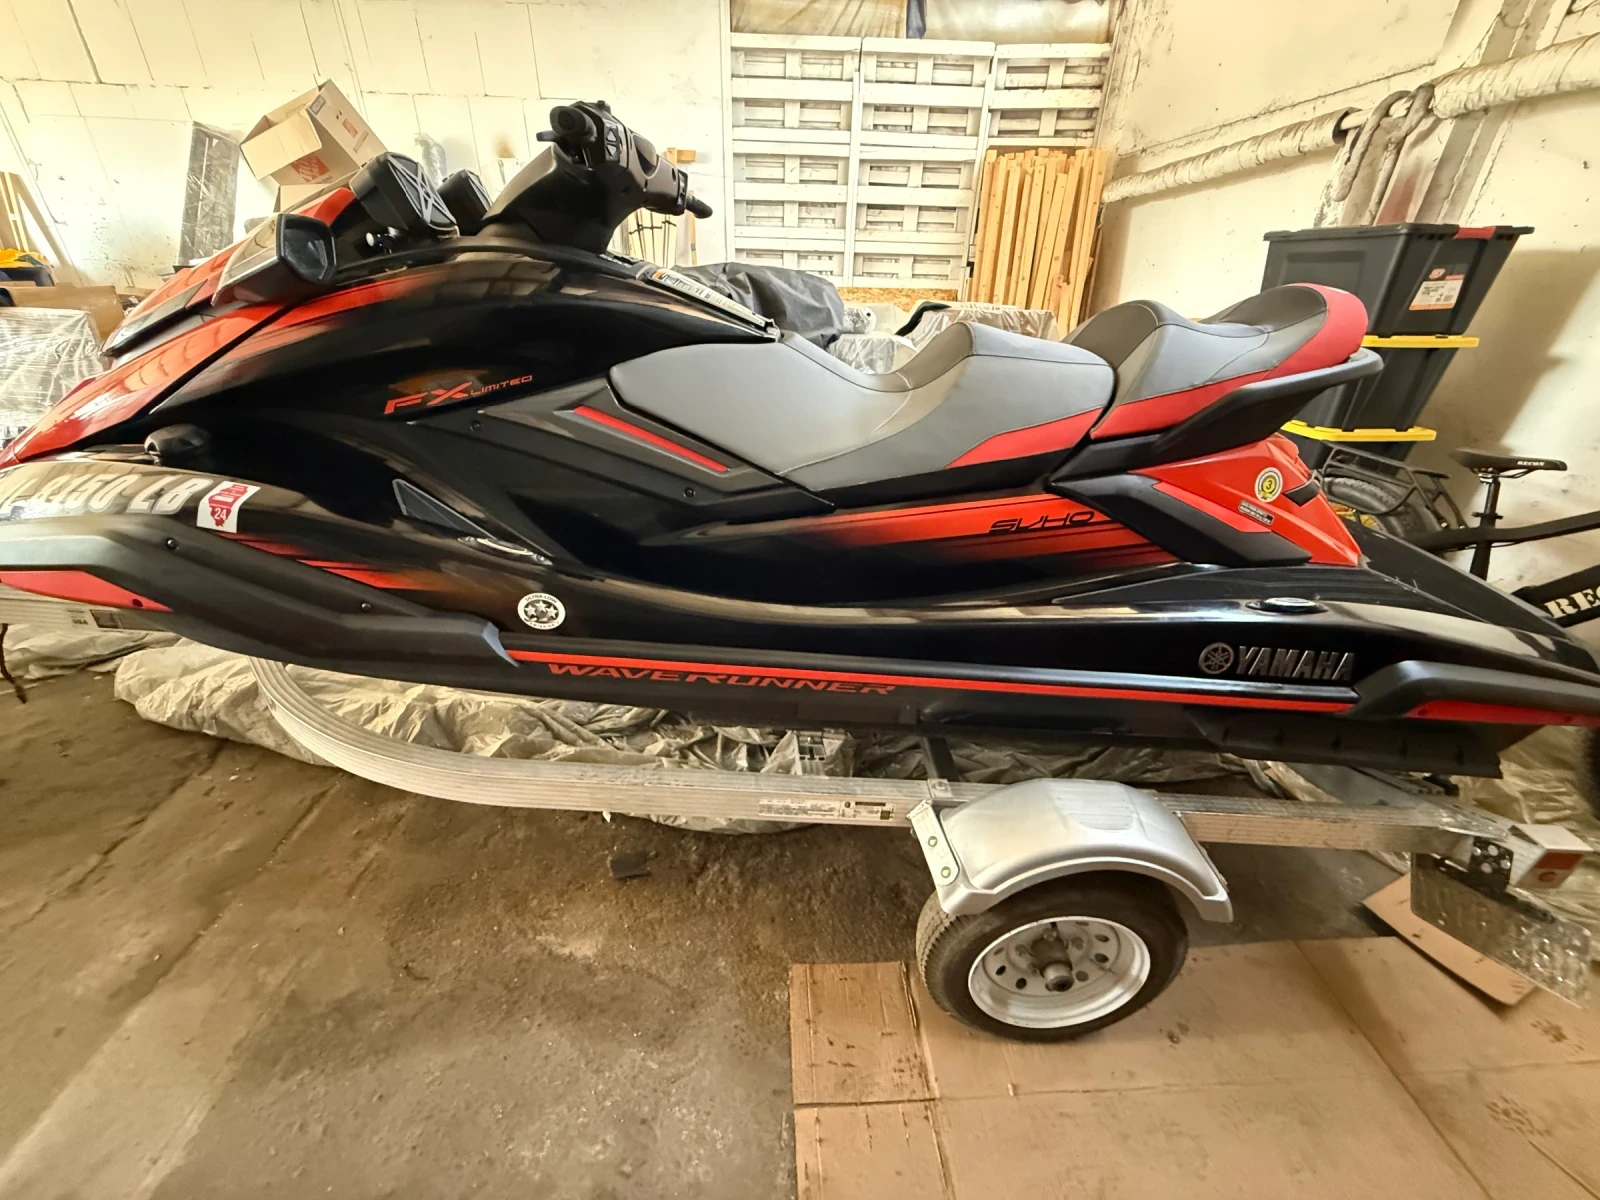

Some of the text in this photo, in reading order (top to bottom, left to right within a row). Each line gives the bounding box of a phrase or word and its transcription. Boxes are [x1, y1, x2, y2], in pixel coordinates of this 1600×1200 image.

[384, 375, 532, 414] FX LIMITED
[126, 474, 213, 514] LB
[1265, 479, 1273, 490] 3
[214, 507, 227, 520] 24
[988, 511, 1094, 534] SVHO
[525, 594, 558, 604] ULTRA LOW
[1543, 585, 1600, 619] RE
[548, 663, 896, 696] WAVERUNNER
[1236, 645, 1354, 681] YAMAHA
